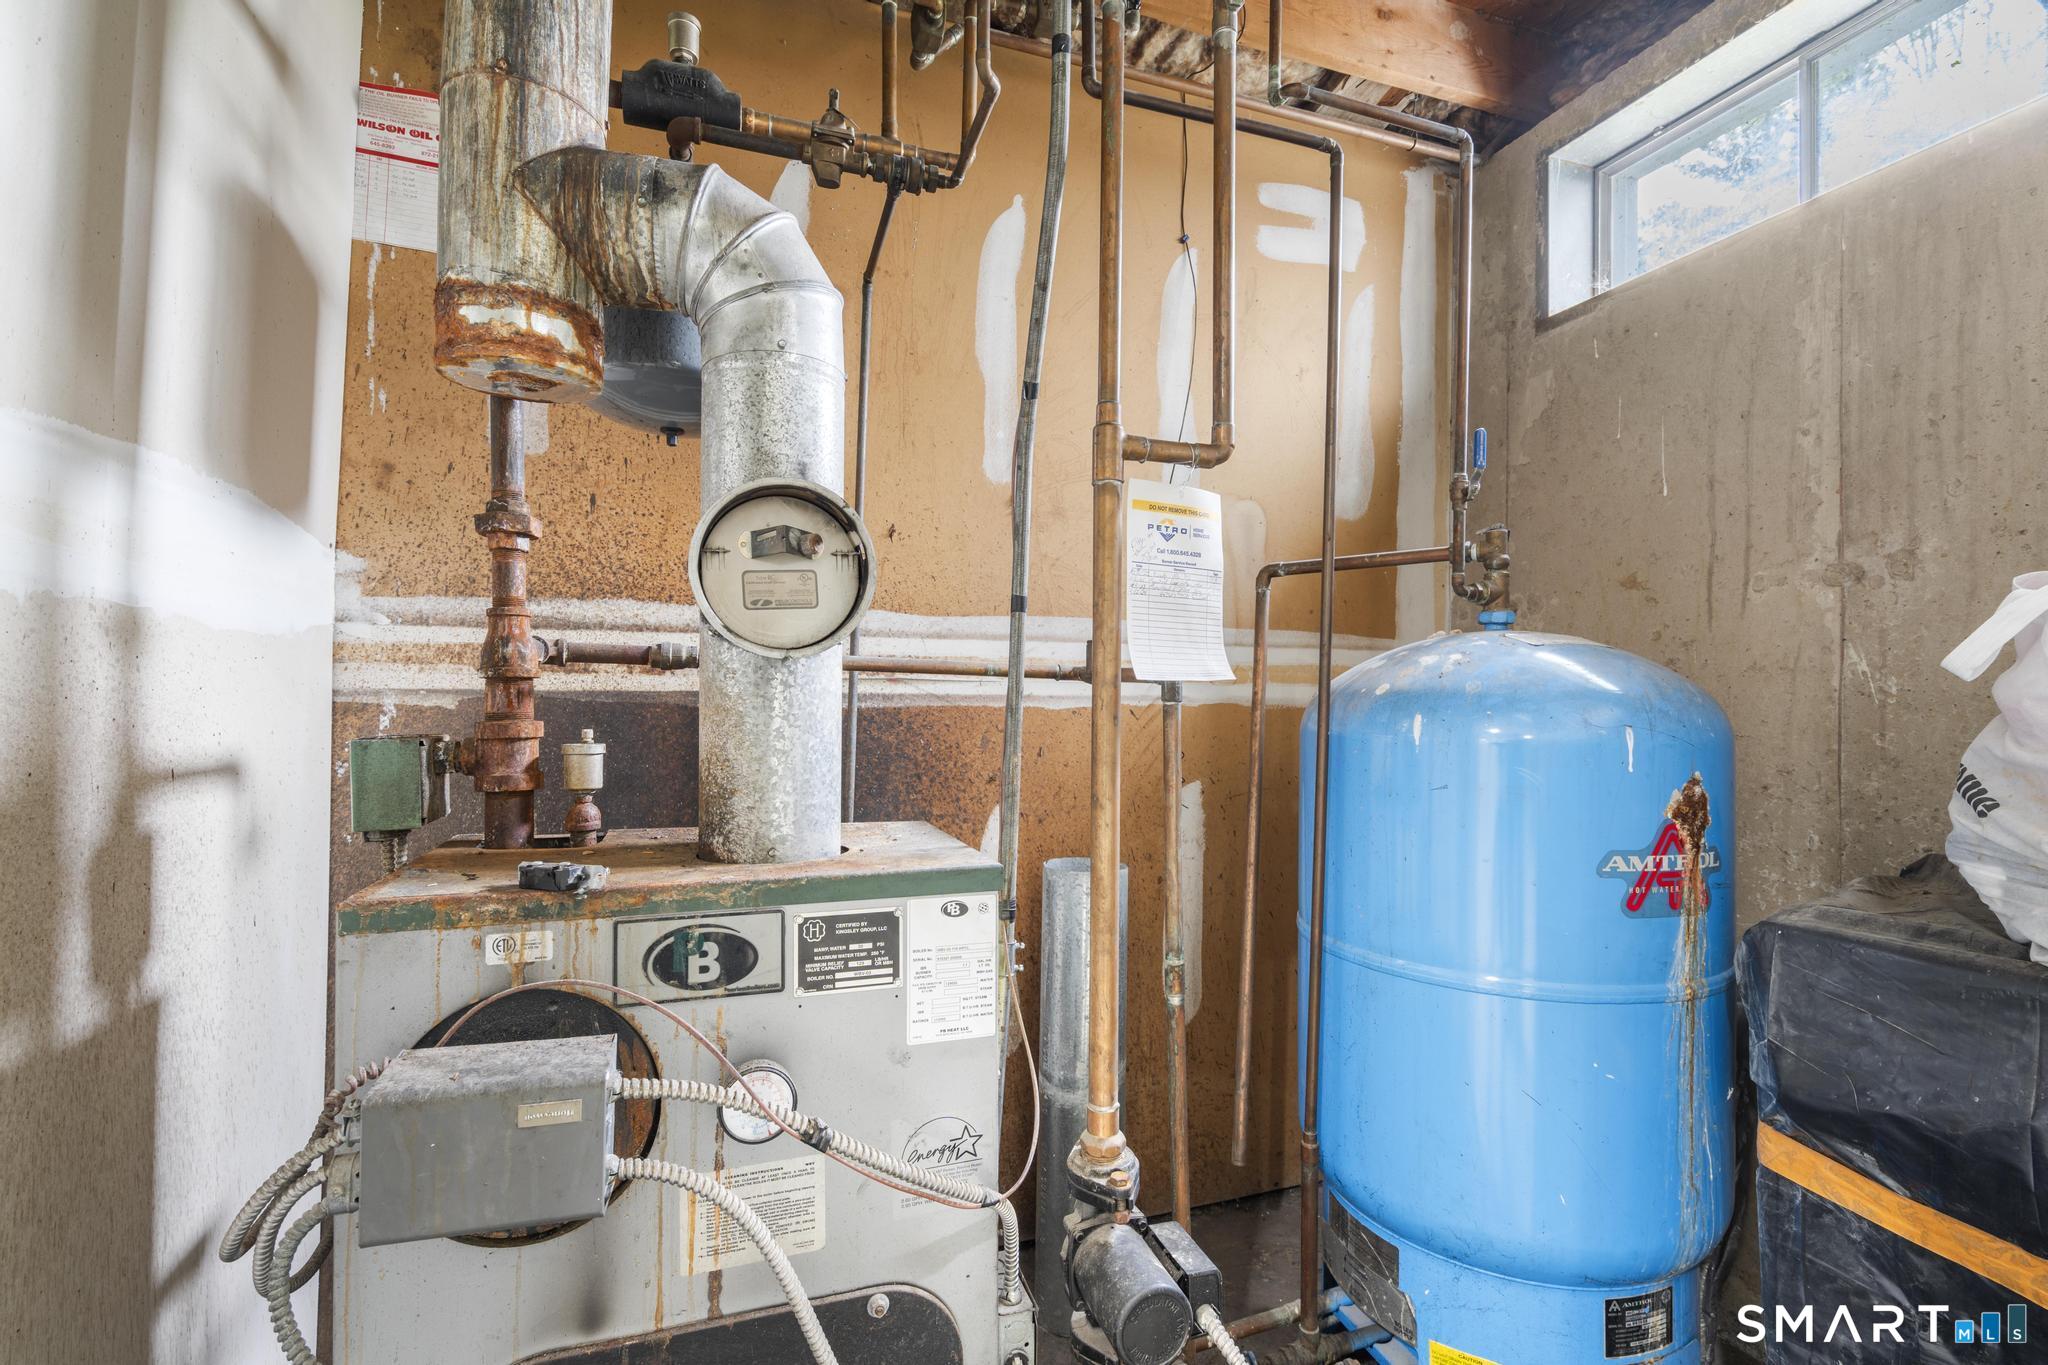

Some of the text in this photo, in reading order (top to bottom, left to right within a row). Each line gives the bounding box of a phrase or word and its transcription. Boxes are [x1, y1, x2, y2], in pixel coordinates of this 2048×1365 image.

[357, 118, 406, 135] WILSON
[409, 129, 433, 141] OIL
[1147, 523, 1188, 535] PETRO
[1629, 885, 1680, 894] HOT WATER
[809, 923, 820, 938] H
[749, 1166, 784, 1176] INSTRUCTIONS
